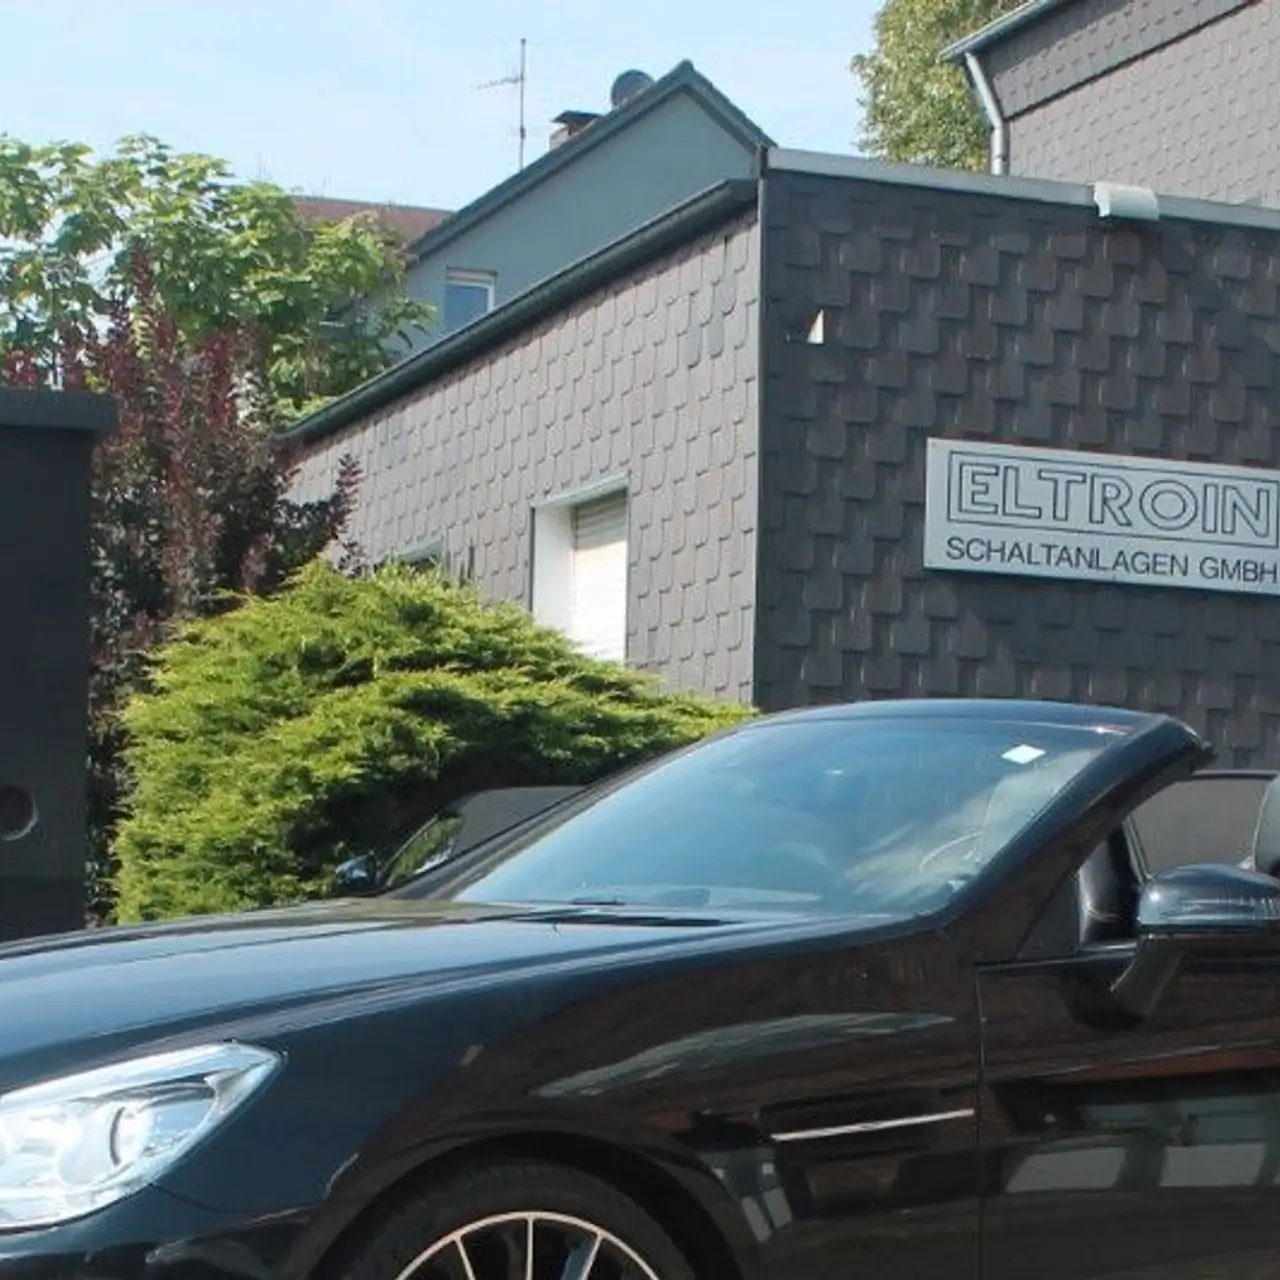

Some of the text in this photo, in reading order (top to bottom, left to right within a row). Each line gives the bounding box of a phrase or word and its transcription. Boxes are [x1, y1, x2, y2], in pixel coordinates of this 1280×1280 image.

[958, 462, 1270, 538] ELTROIN
[946, 536, 1278, 584] SCHALTANLAGEN GMBH
